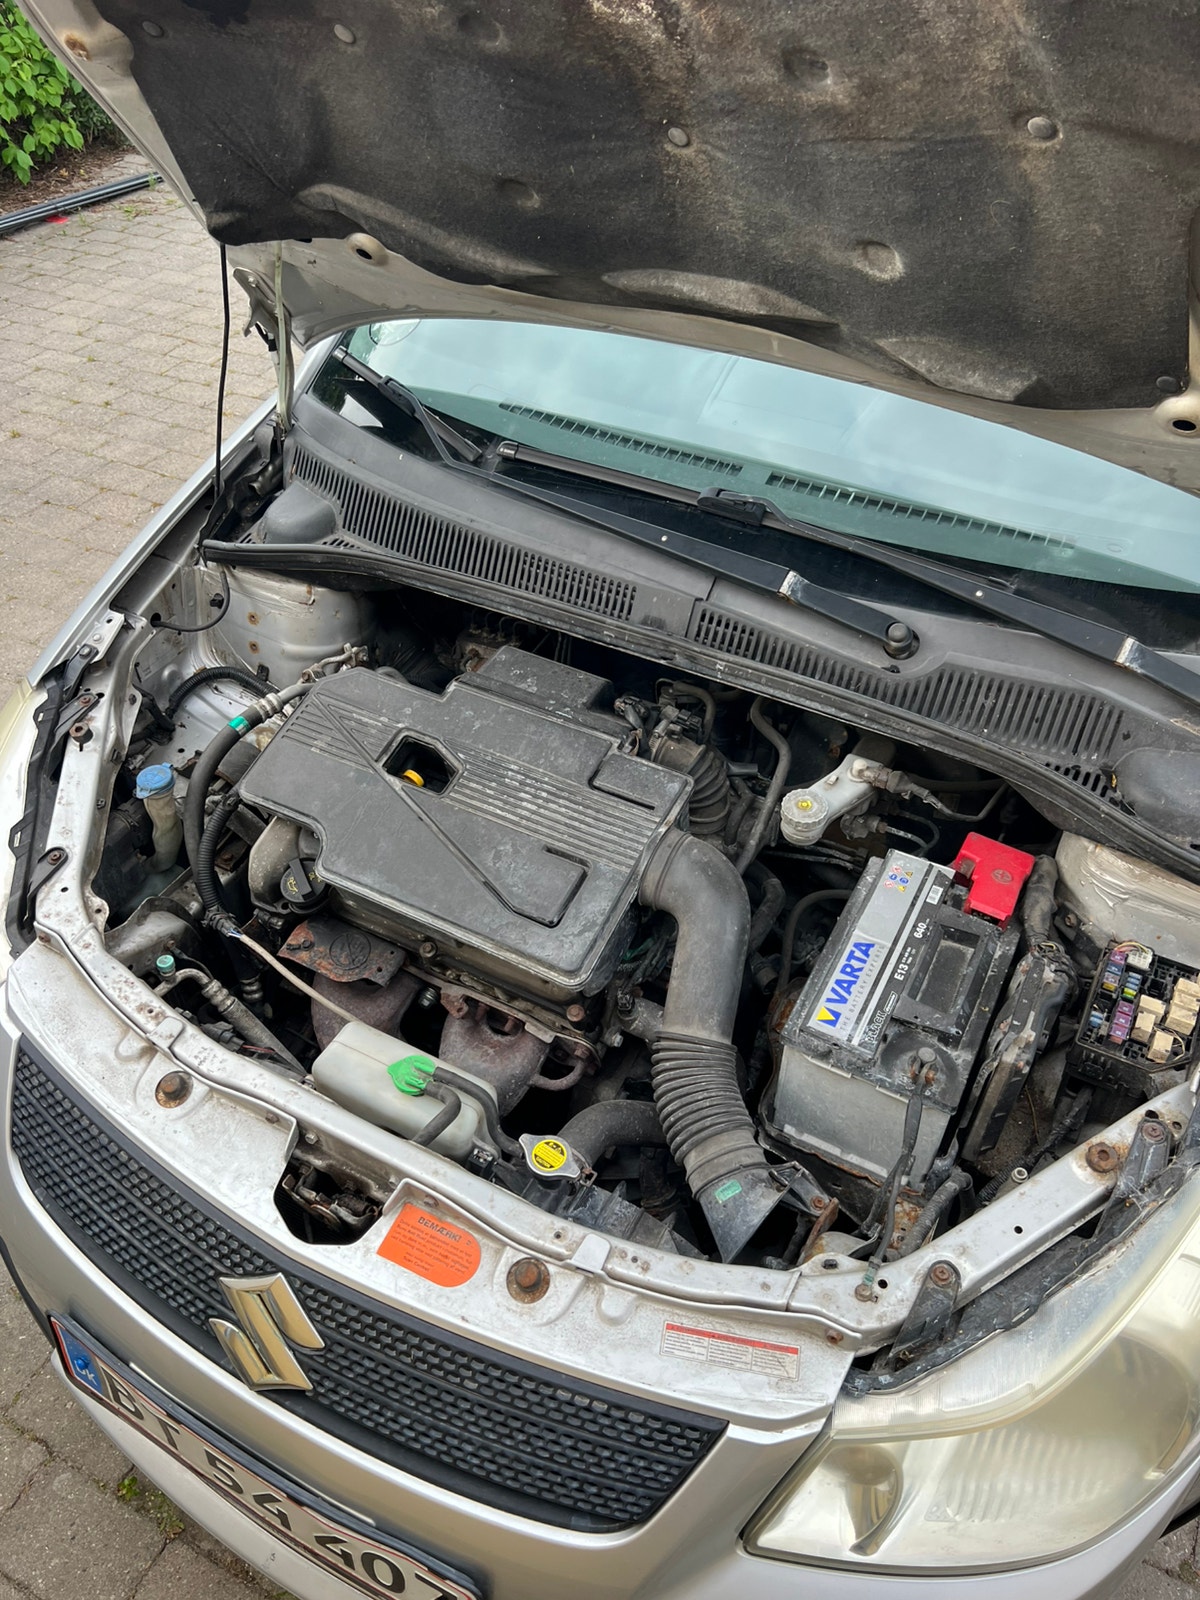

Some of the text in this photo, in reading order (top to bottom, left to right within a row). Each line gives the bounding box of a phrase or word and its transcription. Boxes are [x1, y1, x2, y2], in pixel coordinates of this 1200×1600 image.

[914, 922, 928, 939] 640
[825, 942, 876, 1005] VARTA
[840, 1016, 851, 1031] THE
[849, 980, 867, 1013] BATTERY
[866, 945, 885, 978] EXPERTS
[894, 964, 909, 981] E13
[866, 1010, 886, 1043] BLACK
[418, 1216, 462, 1242] BEMÆRK!
[100, 1363, 181, 1451] BT
[204, 1446, 292, 1531] 54
